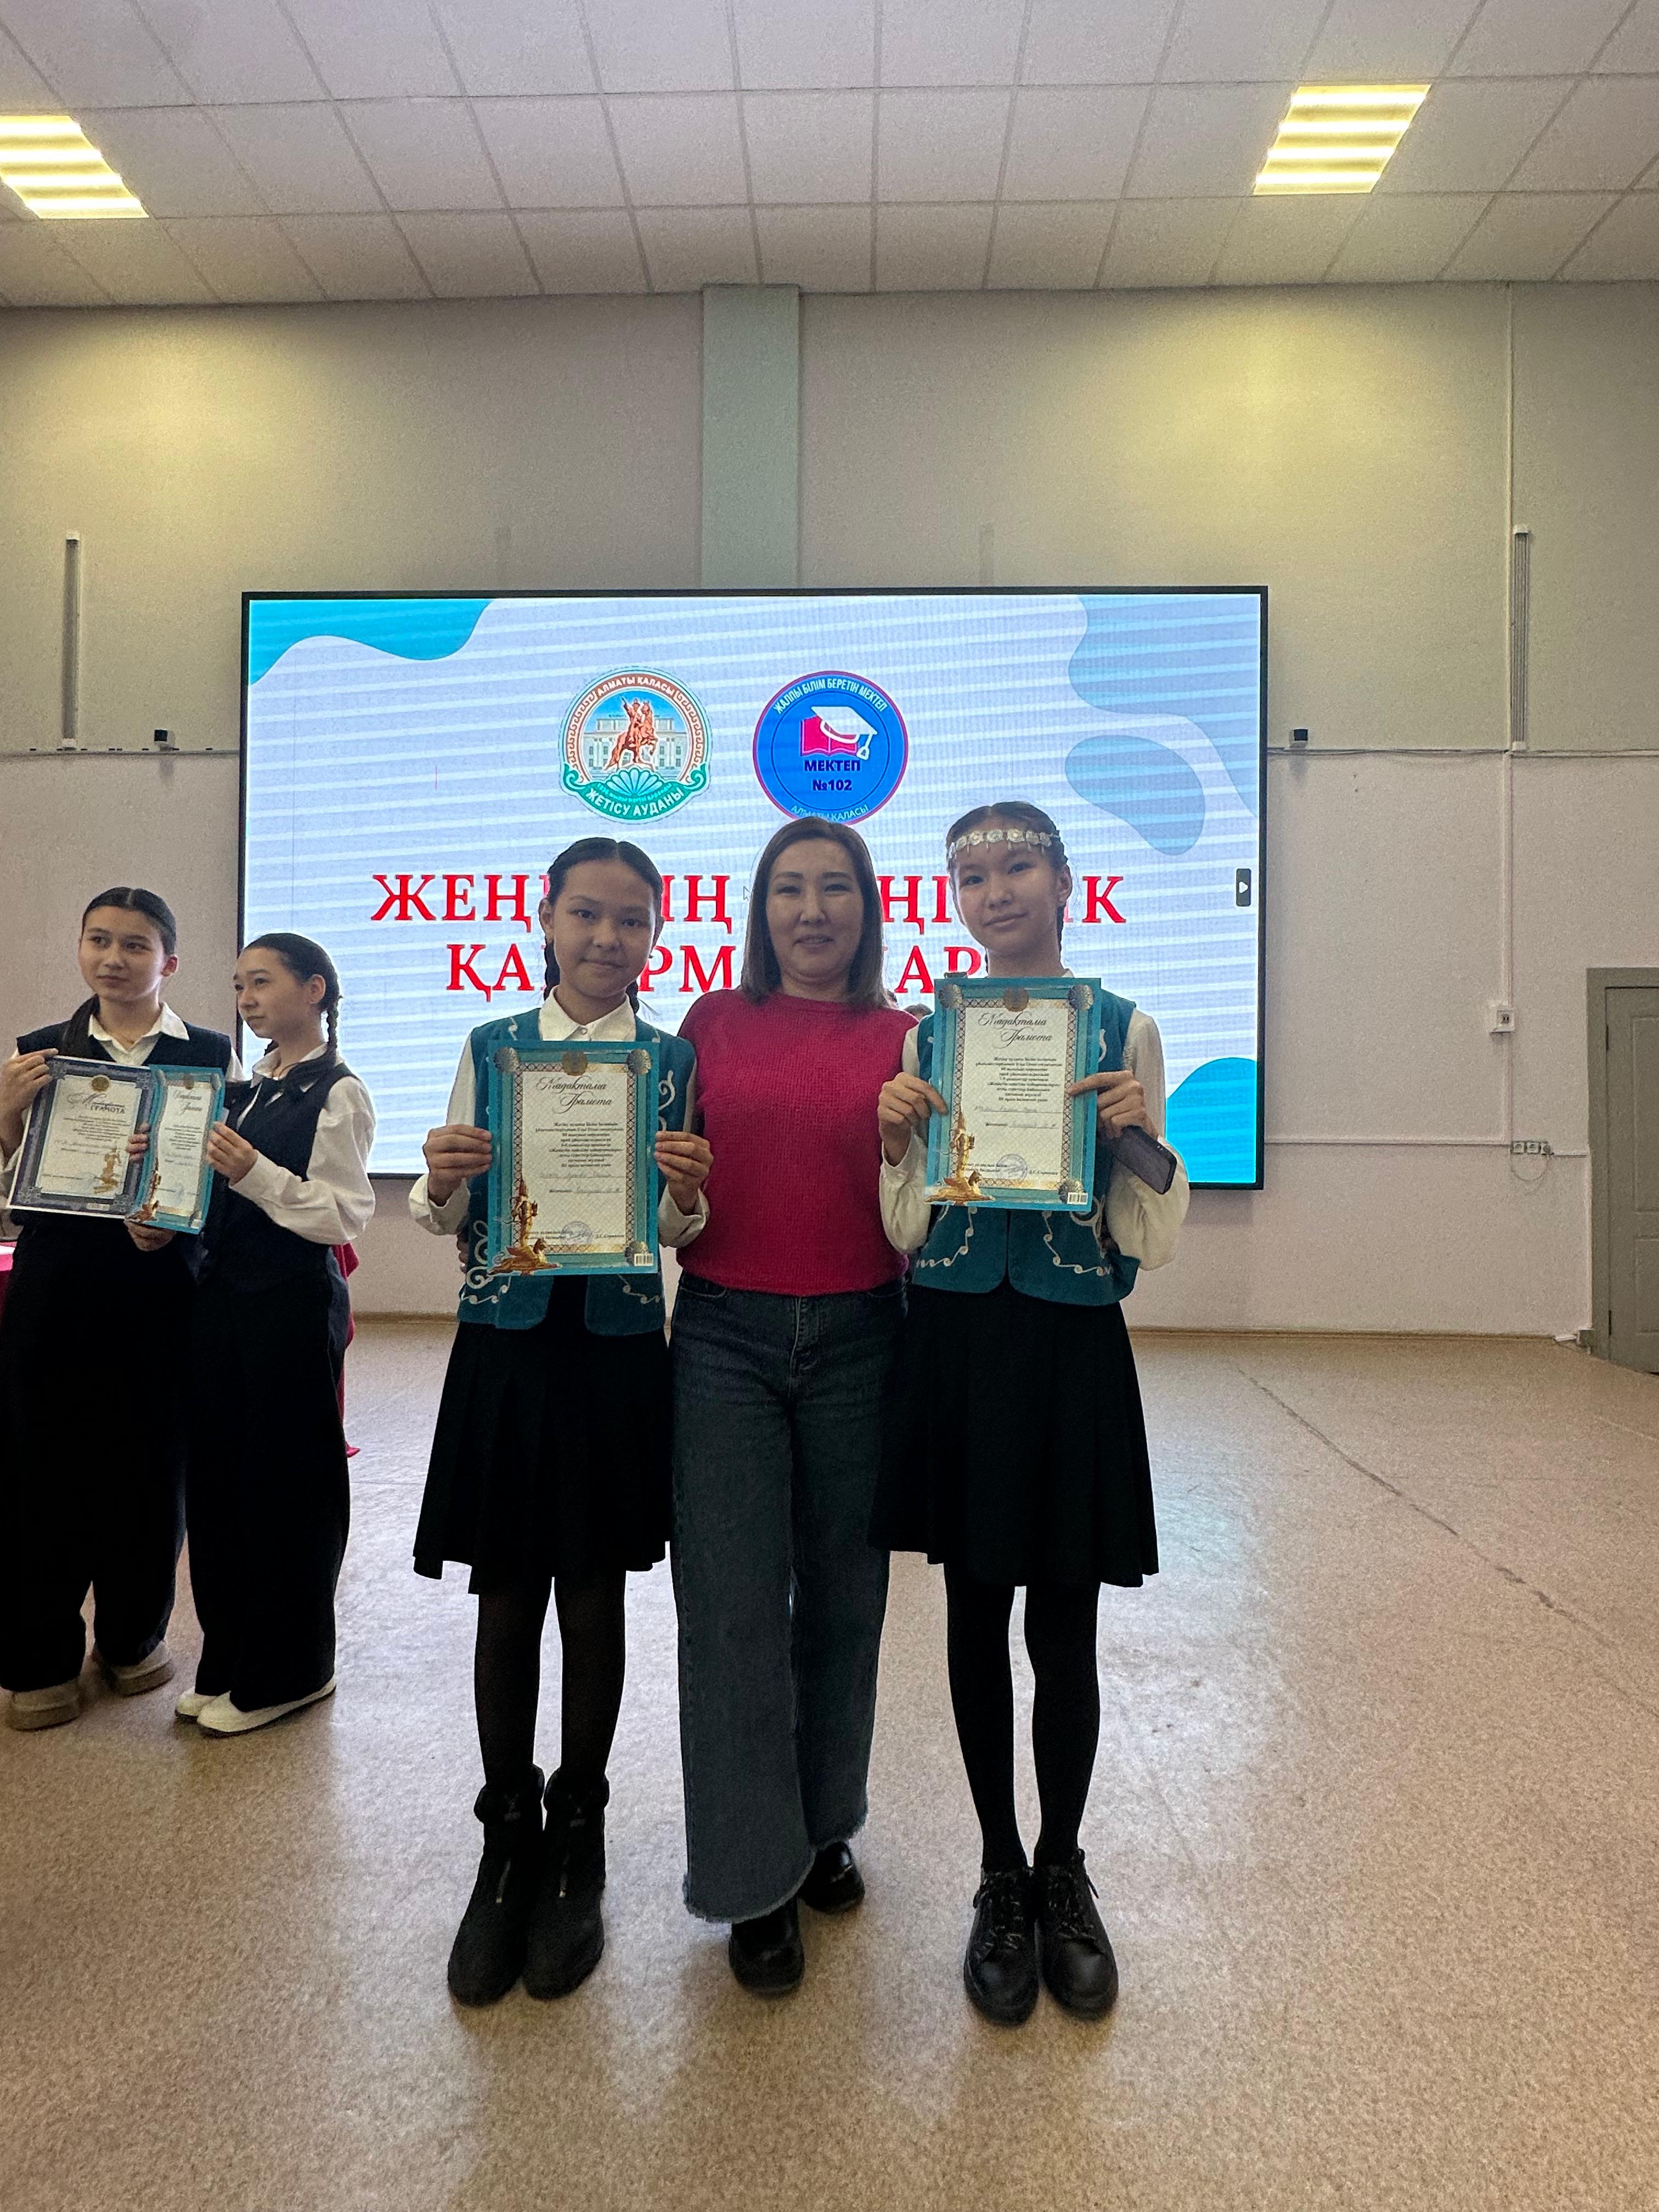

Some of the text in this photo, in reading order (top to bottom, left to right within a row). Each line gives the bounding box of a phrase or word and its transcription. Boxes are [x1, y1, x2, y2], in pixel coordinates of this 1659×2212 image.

[597, 676, 675, 696] АЛМАТЫ ҚАЛАСЫ
[774, 678, 888, 714] ЖАЛПЫ БІЛІМ БЕРЕТІН МЕКТЕП
[804, 760, 861, 771] МЕКТЕП
[812, 779, 852, 791] №102
[585, 787, 630, 816] ЖЕТІСУ
[633, 787, 684, 816] АУДАНЫ
